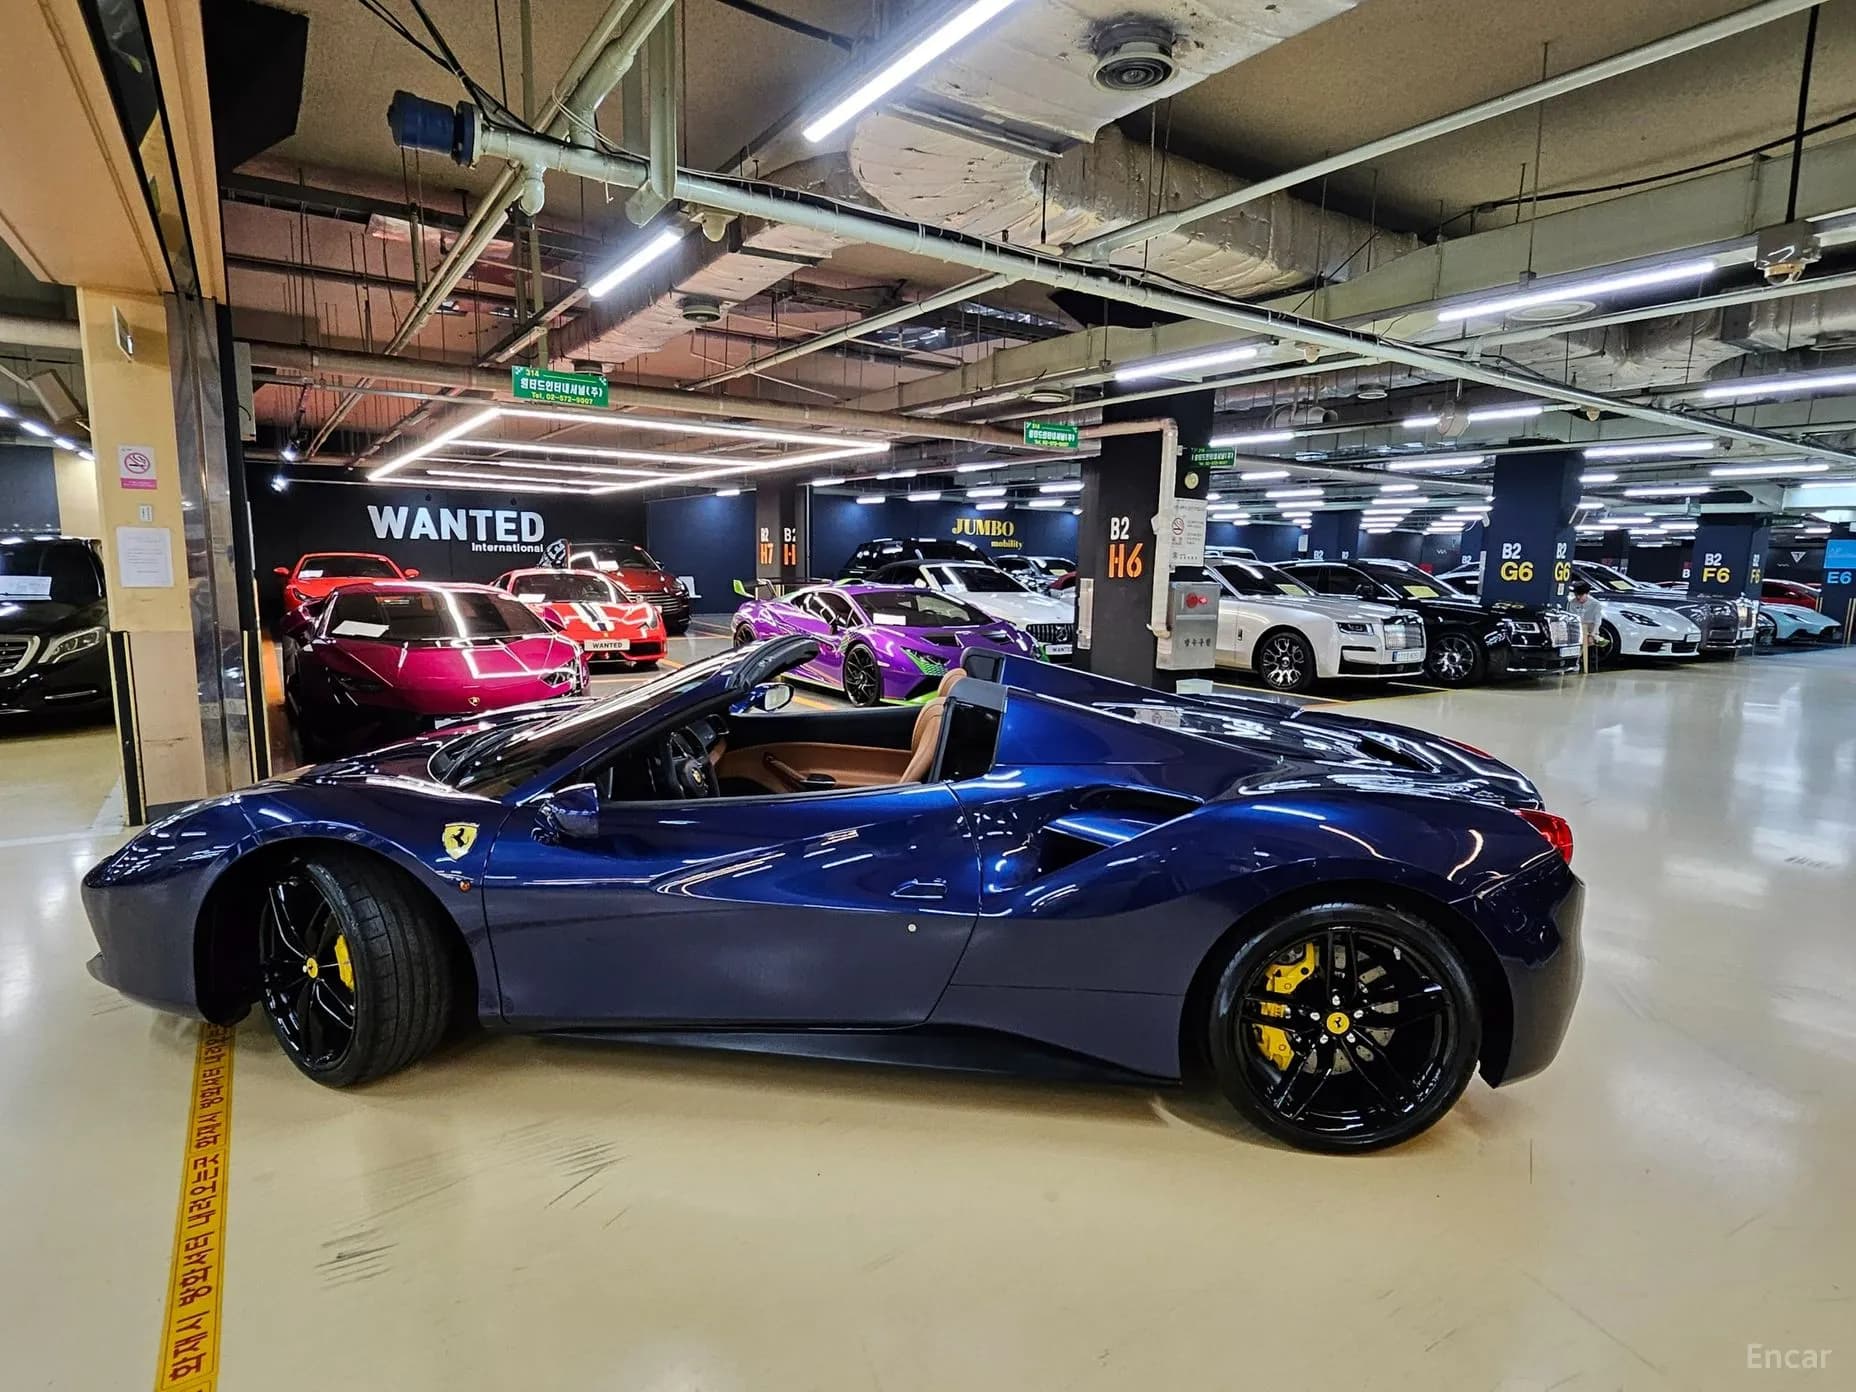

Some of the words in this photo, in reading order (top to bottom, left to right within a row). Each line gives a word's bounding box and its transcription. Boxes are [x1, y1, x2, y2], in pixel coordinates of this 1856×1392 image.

[367, 505, 545, 543] WANTED
[951, 518, 1015, 537] JUMBO
[1110, 516, 1130, 540] B2
[471, 542, 544, 553] International
[760, 543, 774, 565] H7
[991, 539, 1023, 551] mobility
[1502, 542, 1522, 559] B2
[1556, 542, 1567, 559] B2
[1108, 543, 1144, 578] H6
[1704, 553, 1722, 566] B2
[1501, 561, 1534, 582] G6
[1554, 561, 1571, 582] G6
[1702, 567, 1731, 583] F6
[1827, 571, 1852, 584] E6
[187, 1153, 220, 1229] 내려오는곳
[178, 1231, 215, 1307] 방화셔터
[168, 1311, 210, 1381] 화재시
